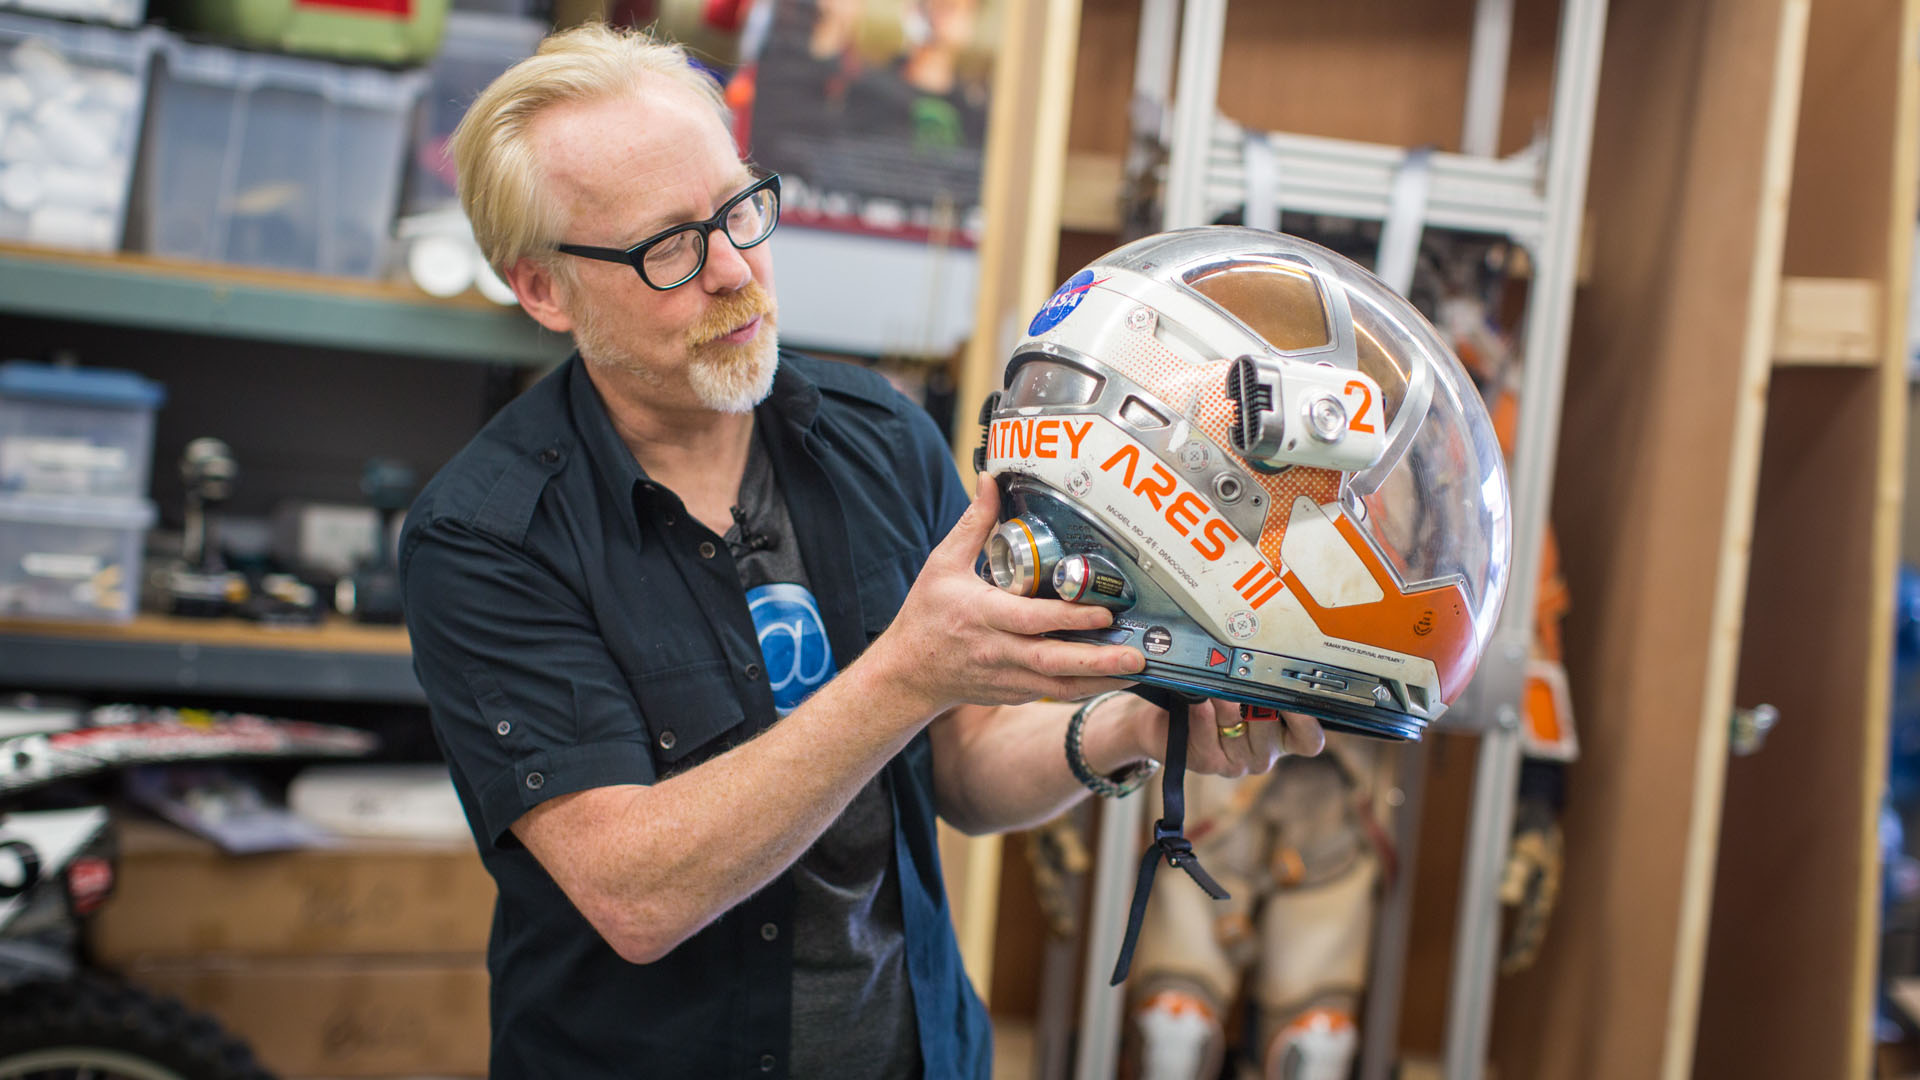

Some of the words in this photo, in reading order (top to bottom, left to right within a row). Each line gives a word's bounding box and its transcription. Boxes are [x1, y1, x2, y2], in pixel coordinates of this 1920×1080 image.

[1042, 292, 1081, 316] NASA
[1344, 380, 1375, 434] 2
[986, 419, 1094, 460] ATNEY
[1099, 443, 1239, 562] ARES
[1232, 560, 1285, 611] III
